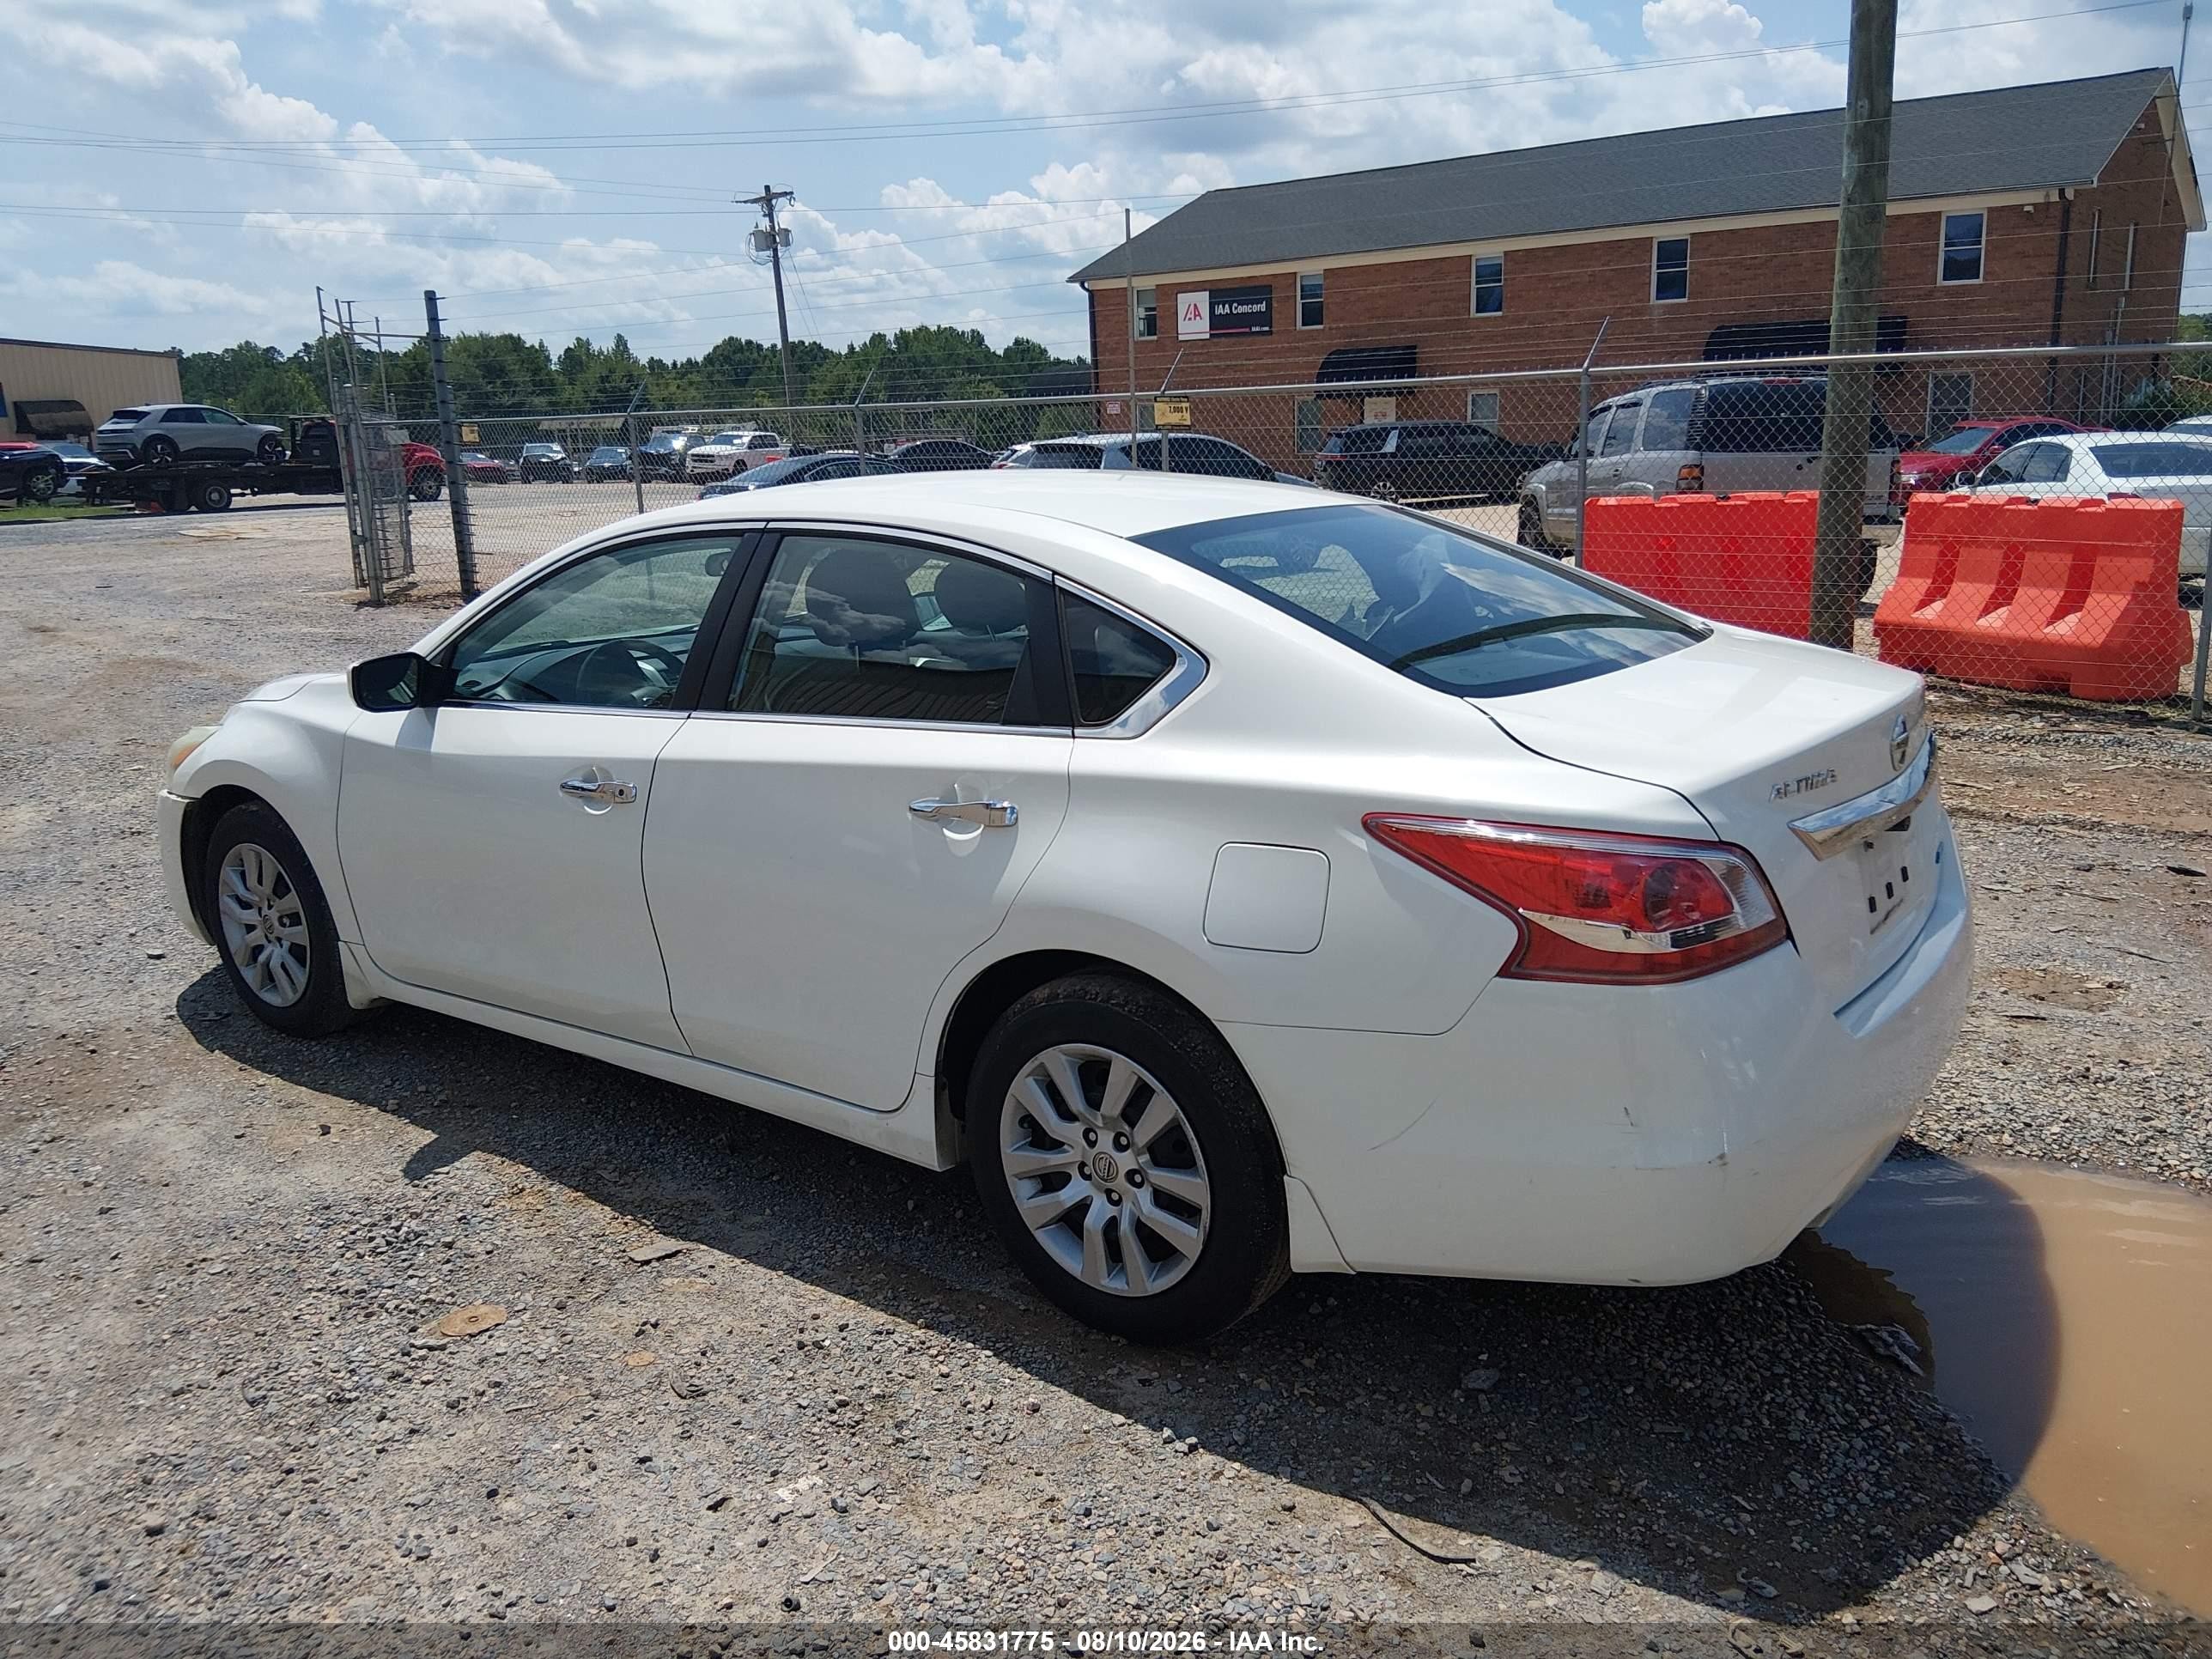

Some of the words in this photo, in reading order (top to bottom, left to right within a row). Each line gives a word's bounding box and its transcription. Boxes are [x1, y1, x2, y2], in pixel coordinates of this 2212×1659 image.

[1214, 304, 1231, 316] IAA
[1231, 301, 1267, 314] Concord
[1169, 405, 1184, 414] 7,000
[1184, 405, 1188, 414] V
